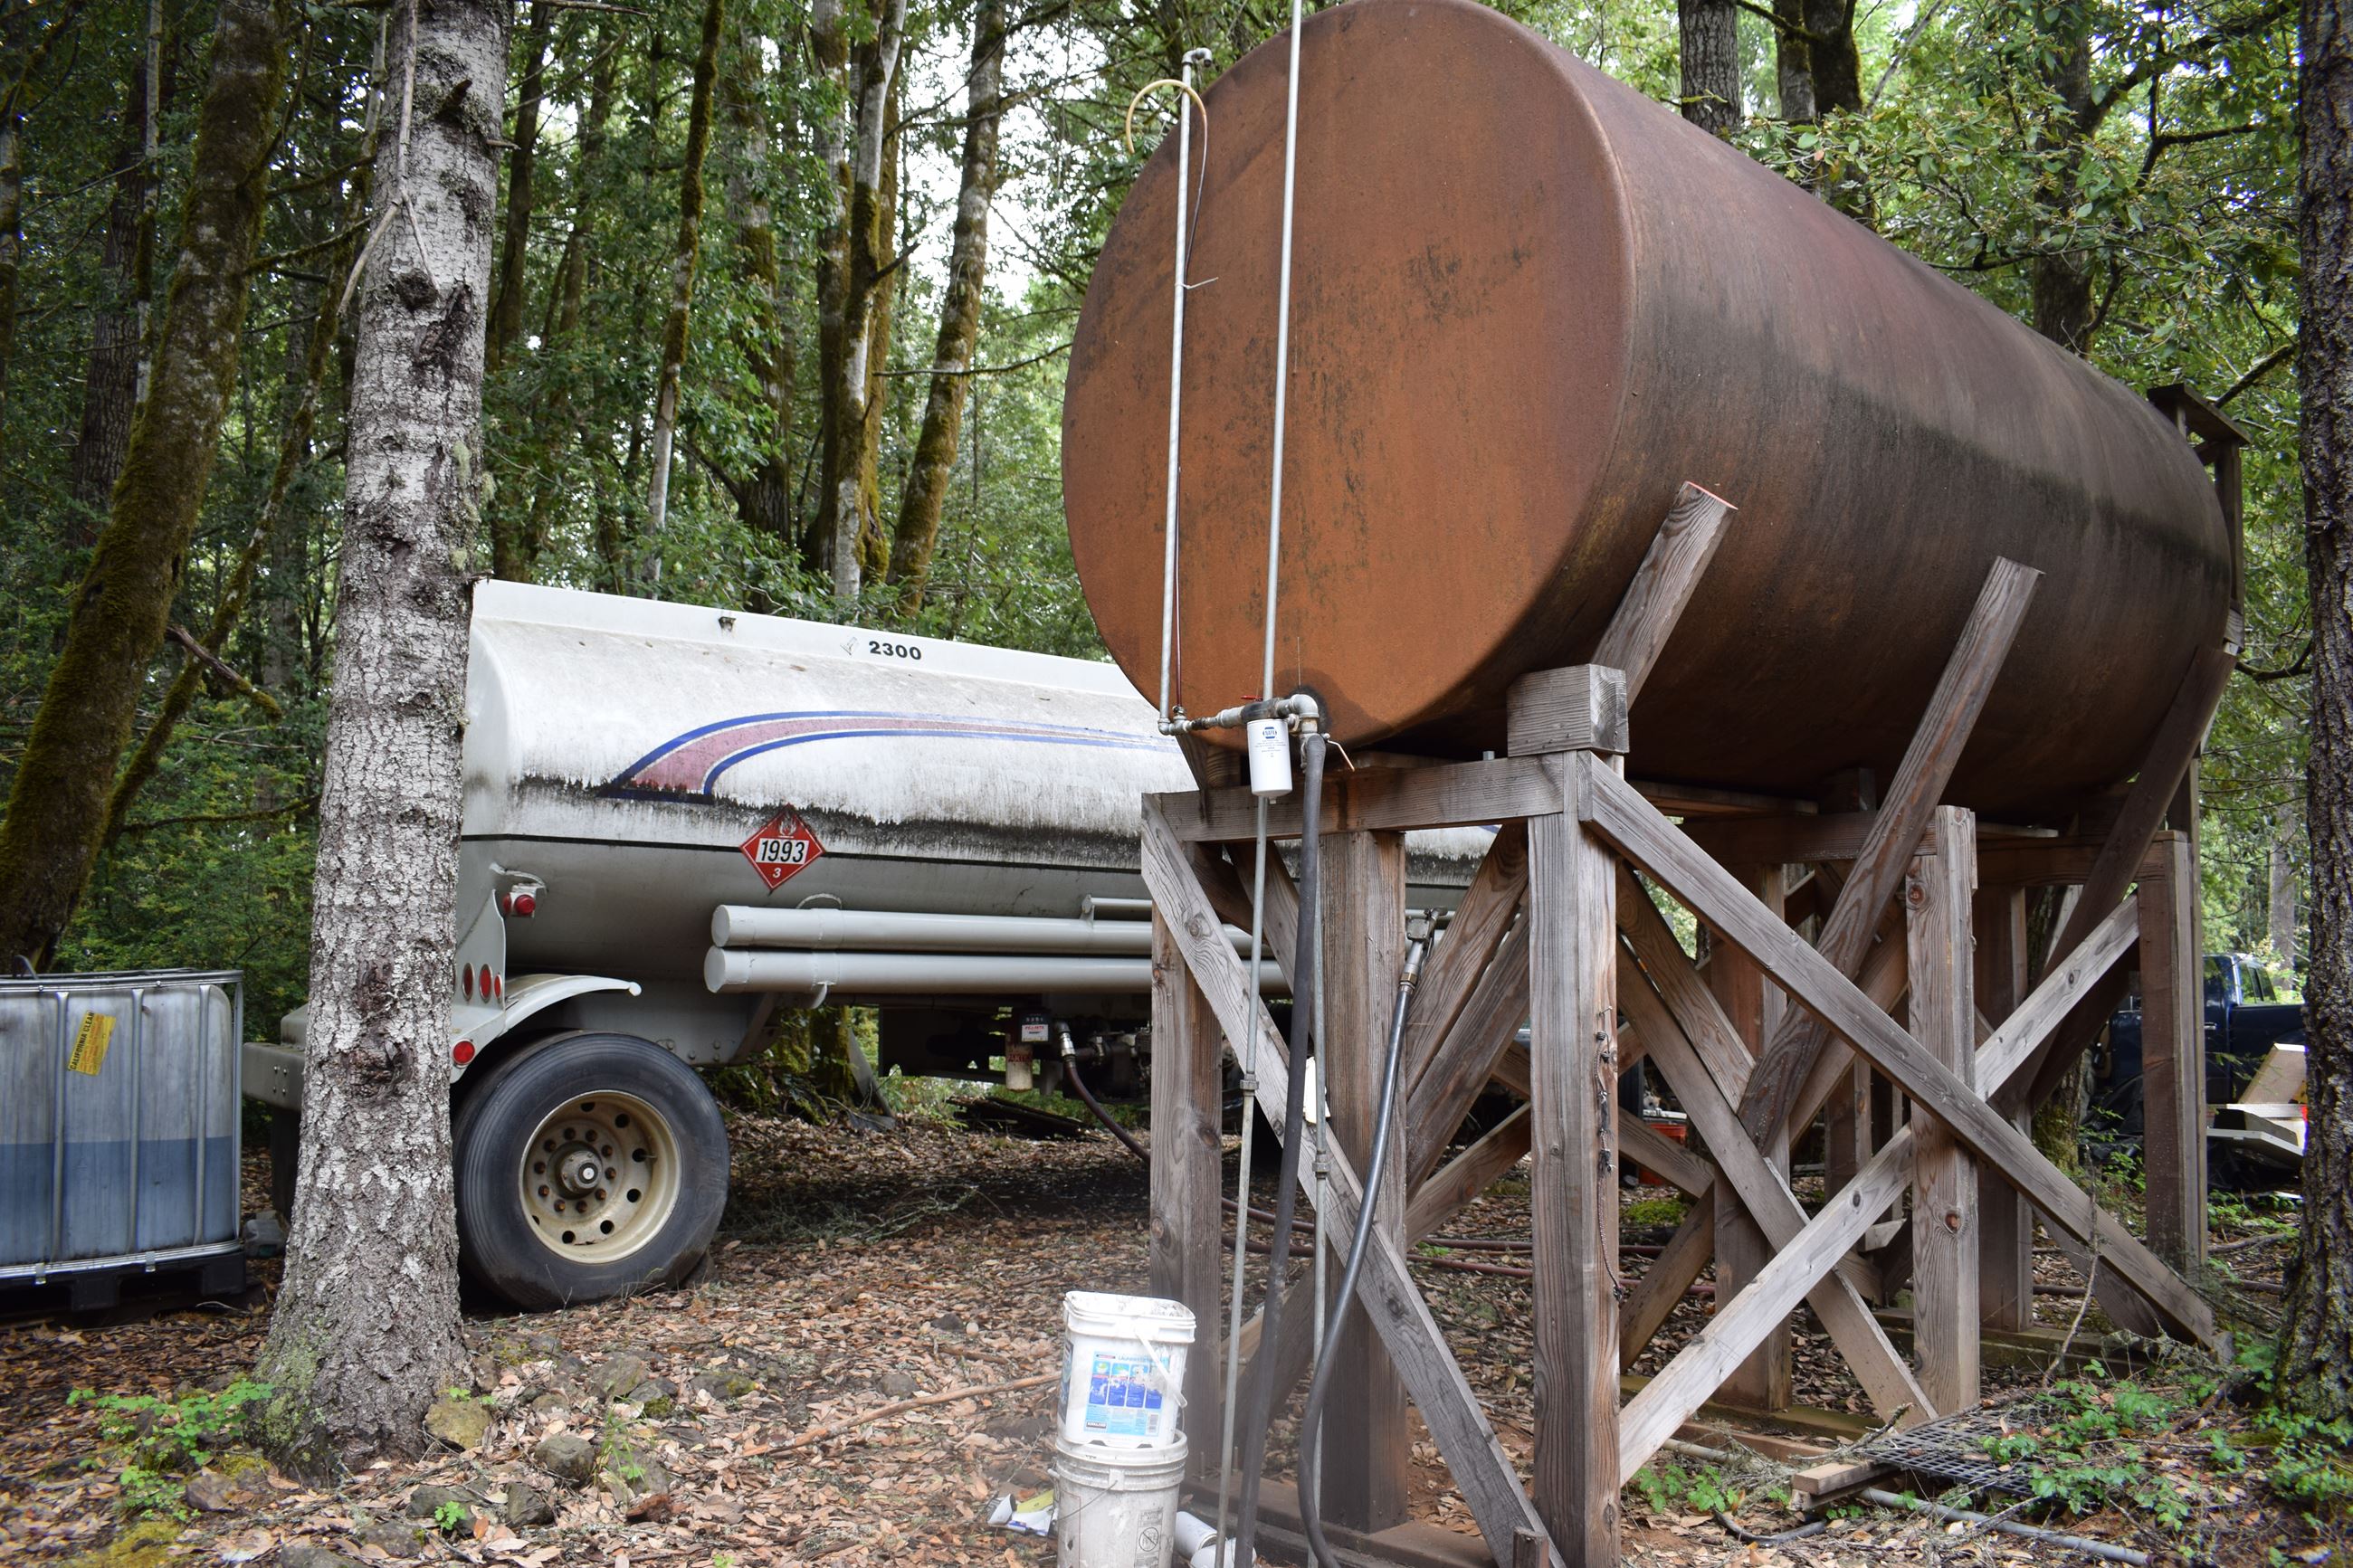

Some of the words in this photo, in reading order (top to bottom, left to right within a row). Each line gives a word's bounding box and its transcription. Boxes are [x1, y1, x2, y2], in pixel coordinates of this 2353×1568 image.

[869, 641, 921, 660] 2300
[761, 840, 805, 863] 1993
[772, 868, 782, 879] 3
[70, 1033, 88, 1070] CALIFORNIA
[83, 1012, 94, 1032] CLEAN
